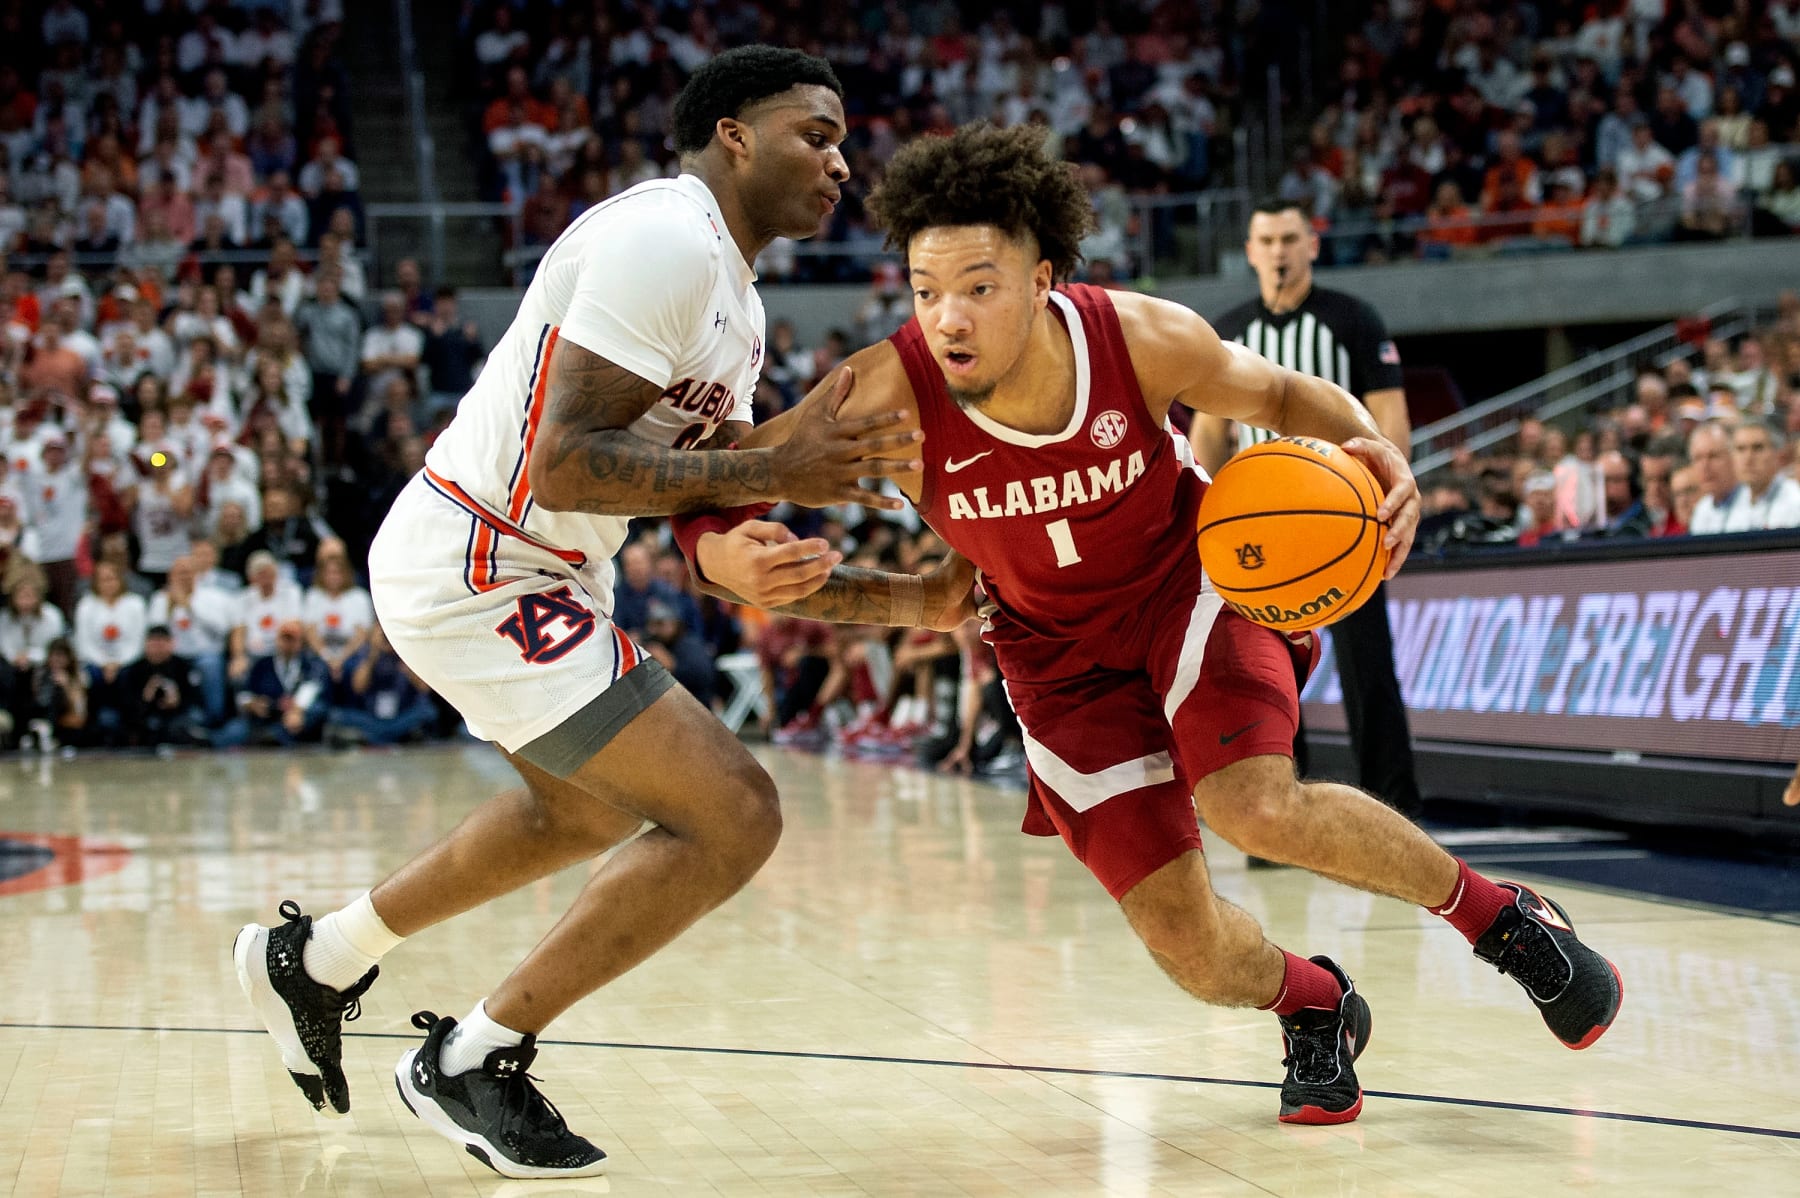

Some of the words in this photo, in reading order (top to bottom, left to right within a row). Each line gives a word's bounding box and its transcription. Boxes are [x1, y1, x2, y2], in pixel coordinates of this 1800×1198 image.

[1092, 411, 1126, 447] SEC
[948, 450, 1146, 520] ALABAMA
[1045, 519, 1082, 568] 1
